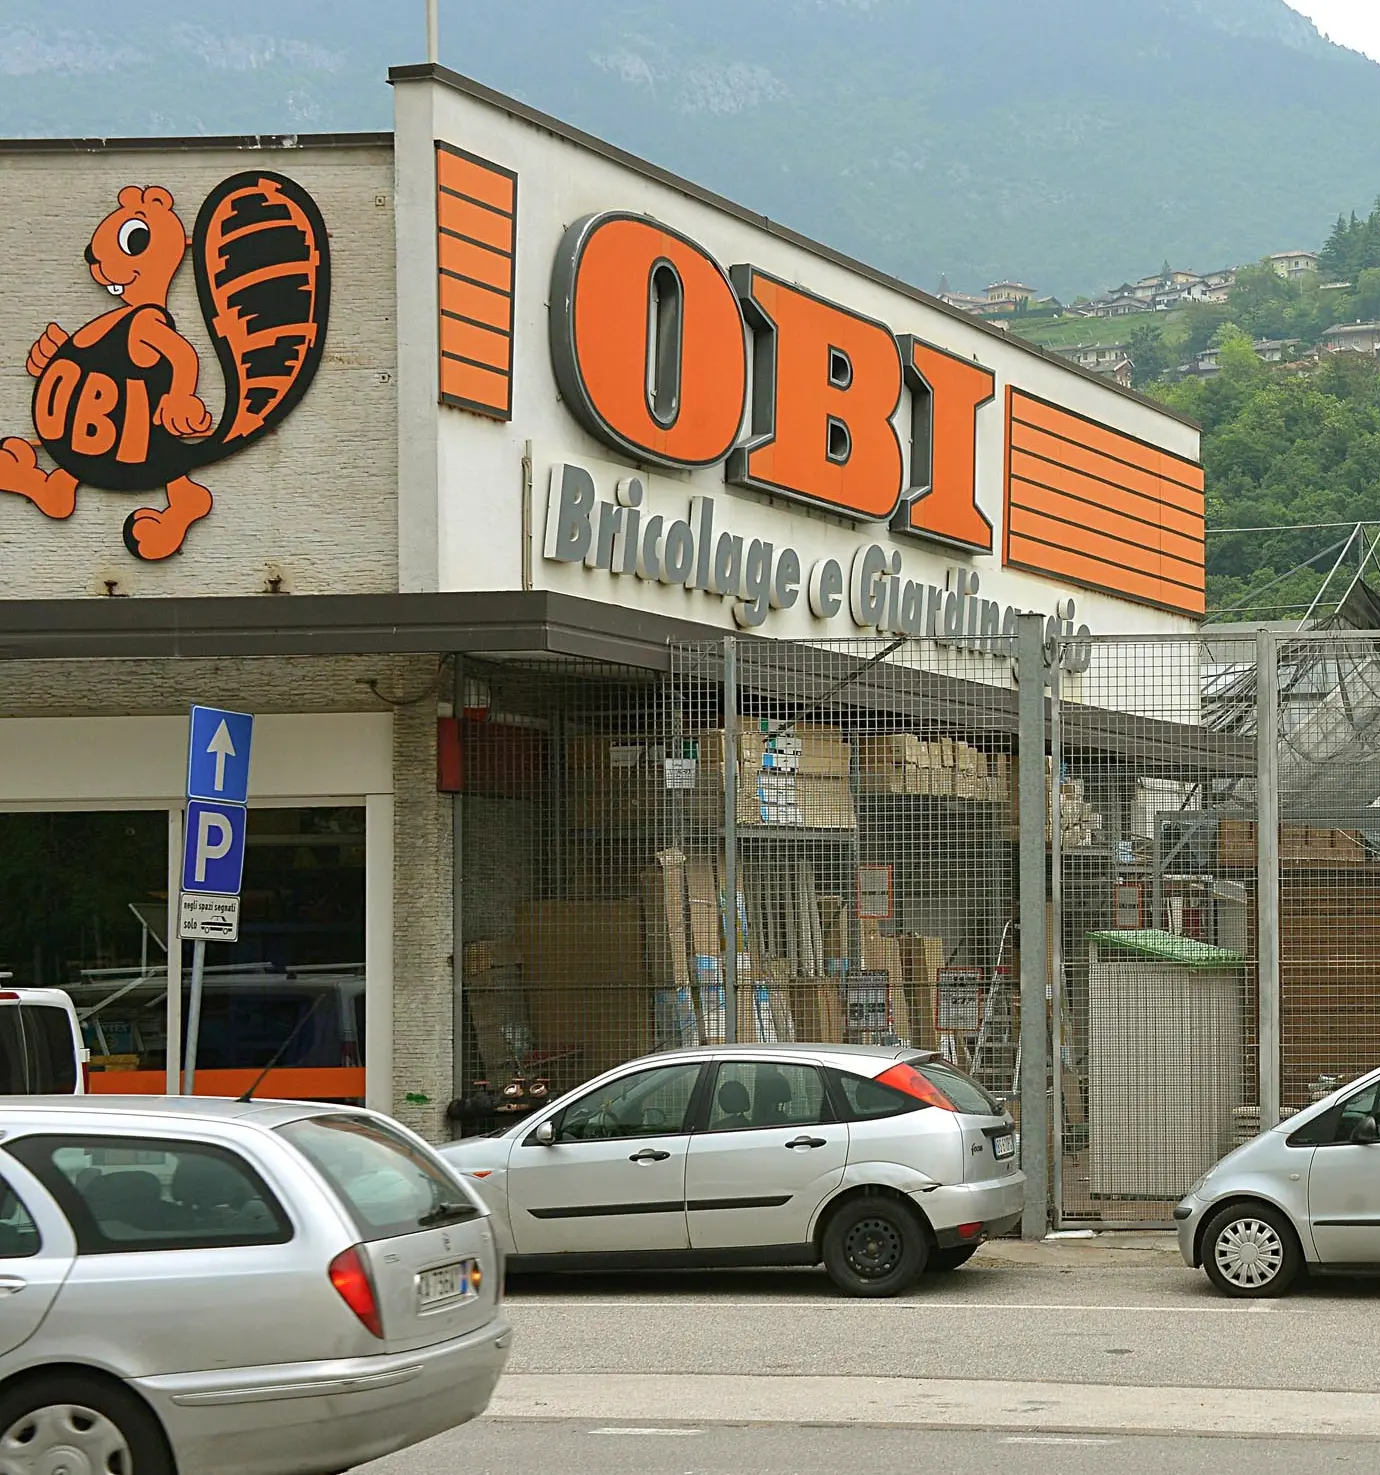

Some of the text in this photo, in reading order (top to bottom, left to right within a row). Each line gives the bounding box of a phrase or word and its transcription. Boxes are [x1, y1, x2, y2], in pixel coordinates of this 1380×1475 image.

[35, 358, 150, 464] OBI
[549, 210, 996, 556] OBI
[544, 464, 800, 627] Bricolage
[808, 558, 843, 619] e
[194, 811, 233, 882] P
[183, 918, 197, 929] solo
[198, 901, 213, 912] spazi
